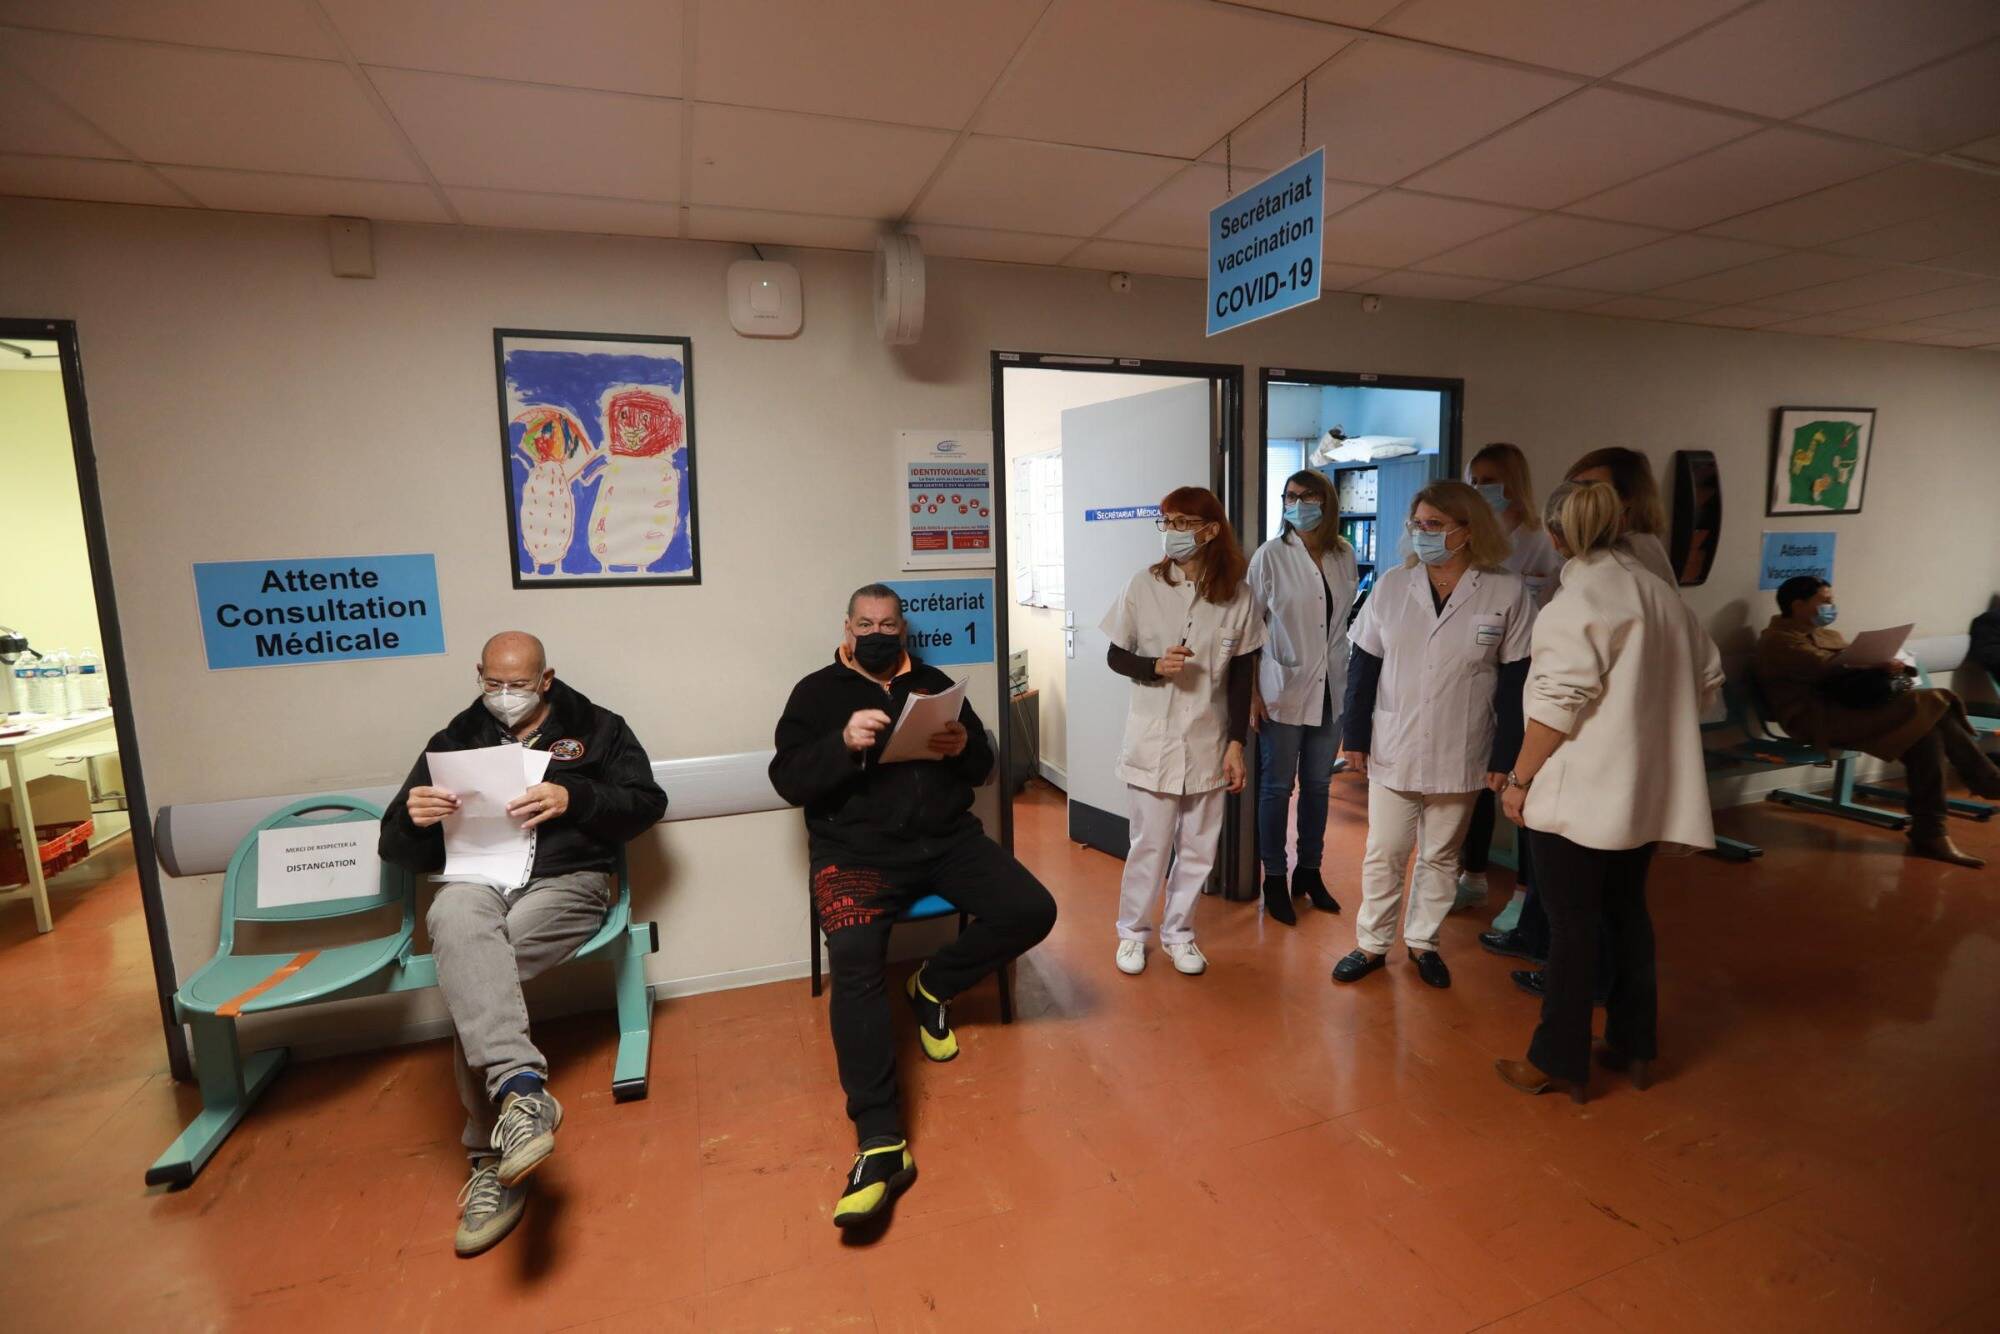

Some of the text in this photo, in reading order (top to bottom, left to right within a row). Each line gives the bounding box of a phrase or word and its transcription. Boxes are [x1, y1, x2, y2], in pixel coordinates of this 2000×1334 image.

[1221, 173, 1312, 239] Secrétariat
[1218, 216, 1314, 273] vaccination
[1216, 257, 1313, 318] COVID-19
[911, 468, 986, 476] IDENTITOVIGILANCE
[261, 567, 378, 593] Attente
[216, 596, 427, 628] Consultation
[901, 592, 984, 613] ecrétariat
[255, 628, 400, 658] Médicale
[908, 621, 976, 648] ntrée 1
[285, 846, 306, 854] MERCI
[316, 842, 348, 850] RESPECTER
[286, 859, 357, 872] DISTANCIATION
